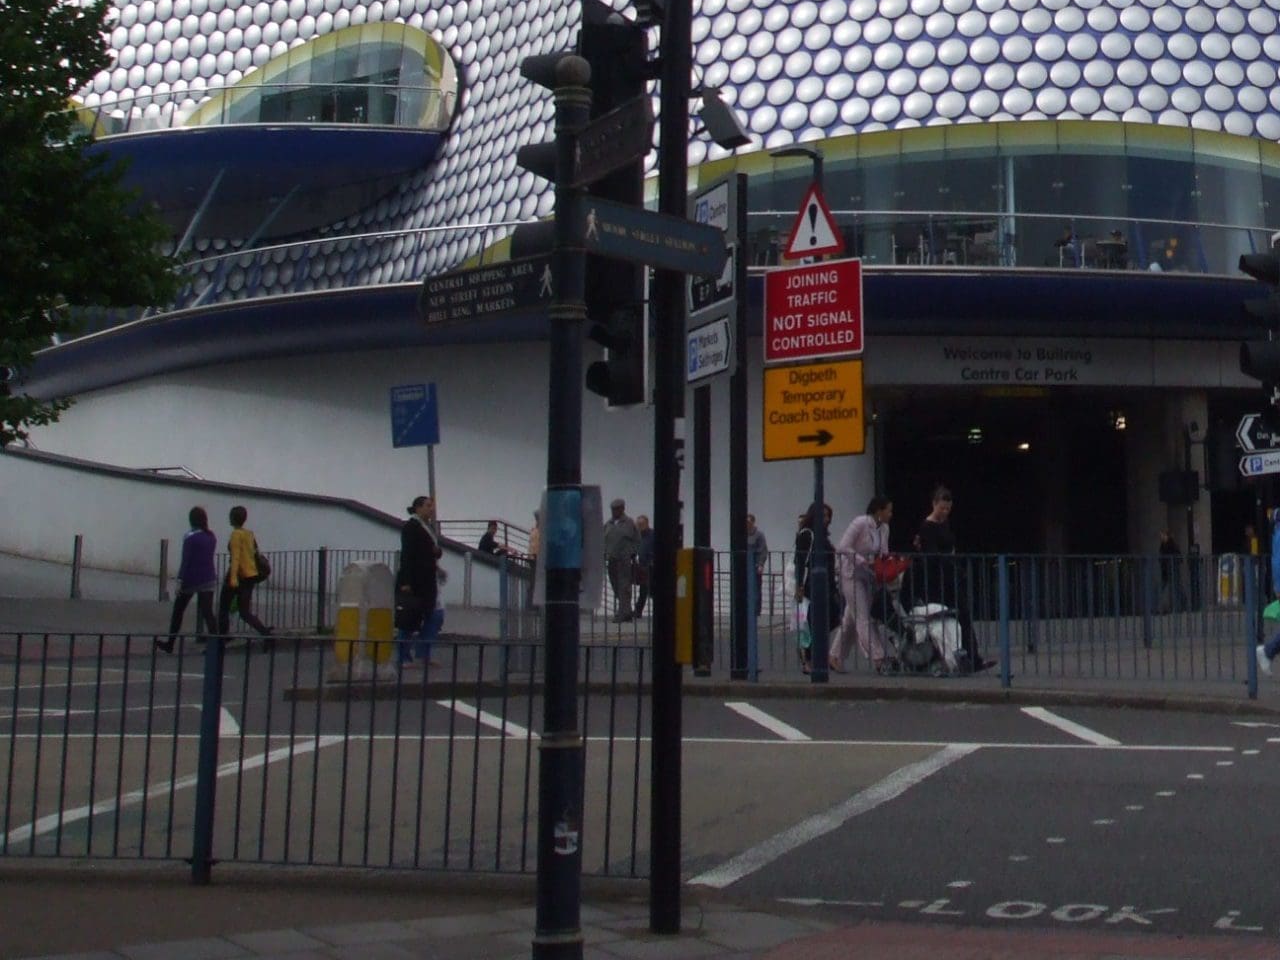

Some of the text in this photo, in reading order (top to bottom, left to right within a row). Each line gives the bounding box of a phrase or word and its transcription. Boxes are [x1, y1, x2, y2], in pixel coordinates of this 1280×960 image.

[428, 277, 464, 293] CENTRAL
[786, 270, 838, 289] JOINING
[482, 282, 514, 297] STATION
[787, 290, 837, 308] TRAFFIC
[773, 310, 854, 331] NOT SIGNAL
[772, 330, 854, 351] CONTROLLED
[944, 346, 1012, 361] Welcome
[1018, 347, 1031, 361] to
[789, 368, 837, 386] Digbeth
[961, 367, 1078, 381] Centre Car Park
[781, 389, 846, 406] Temporary
[769, 406, 858, 425] Coach Station
[920, 899, 1178, 925] LOOK
